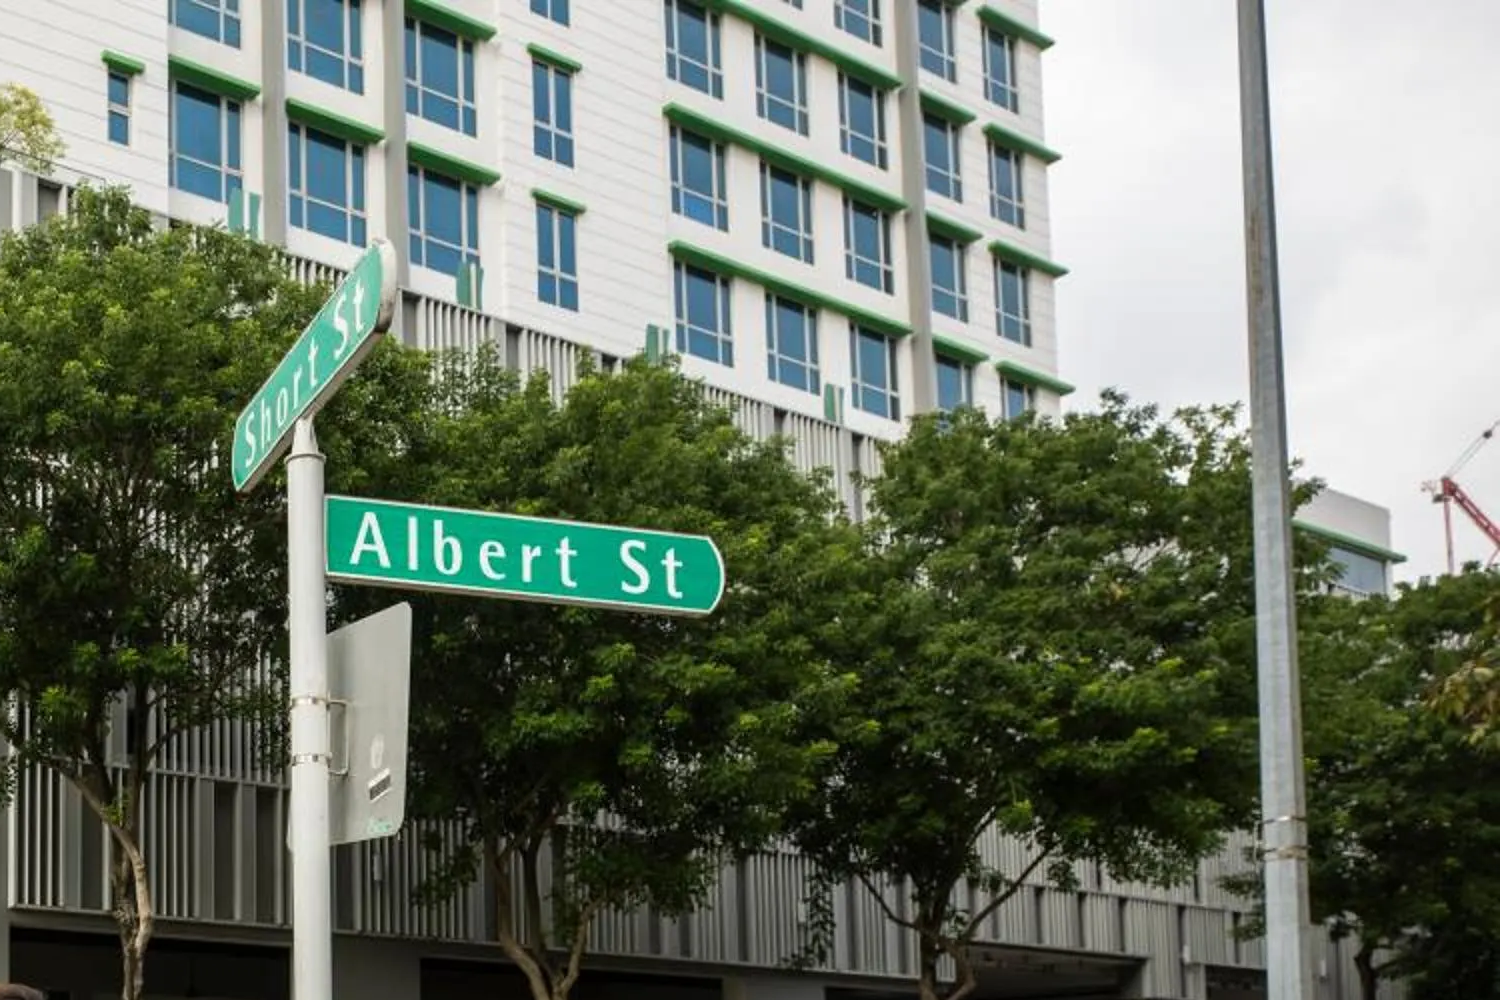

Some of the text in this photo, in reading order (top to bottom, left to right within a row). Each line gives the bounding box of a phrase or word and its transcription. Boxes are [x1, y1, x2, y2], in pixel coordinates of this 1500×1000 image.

[244, 279, 366, 468] Short St
[350, 511, 684, 600] Albert St
